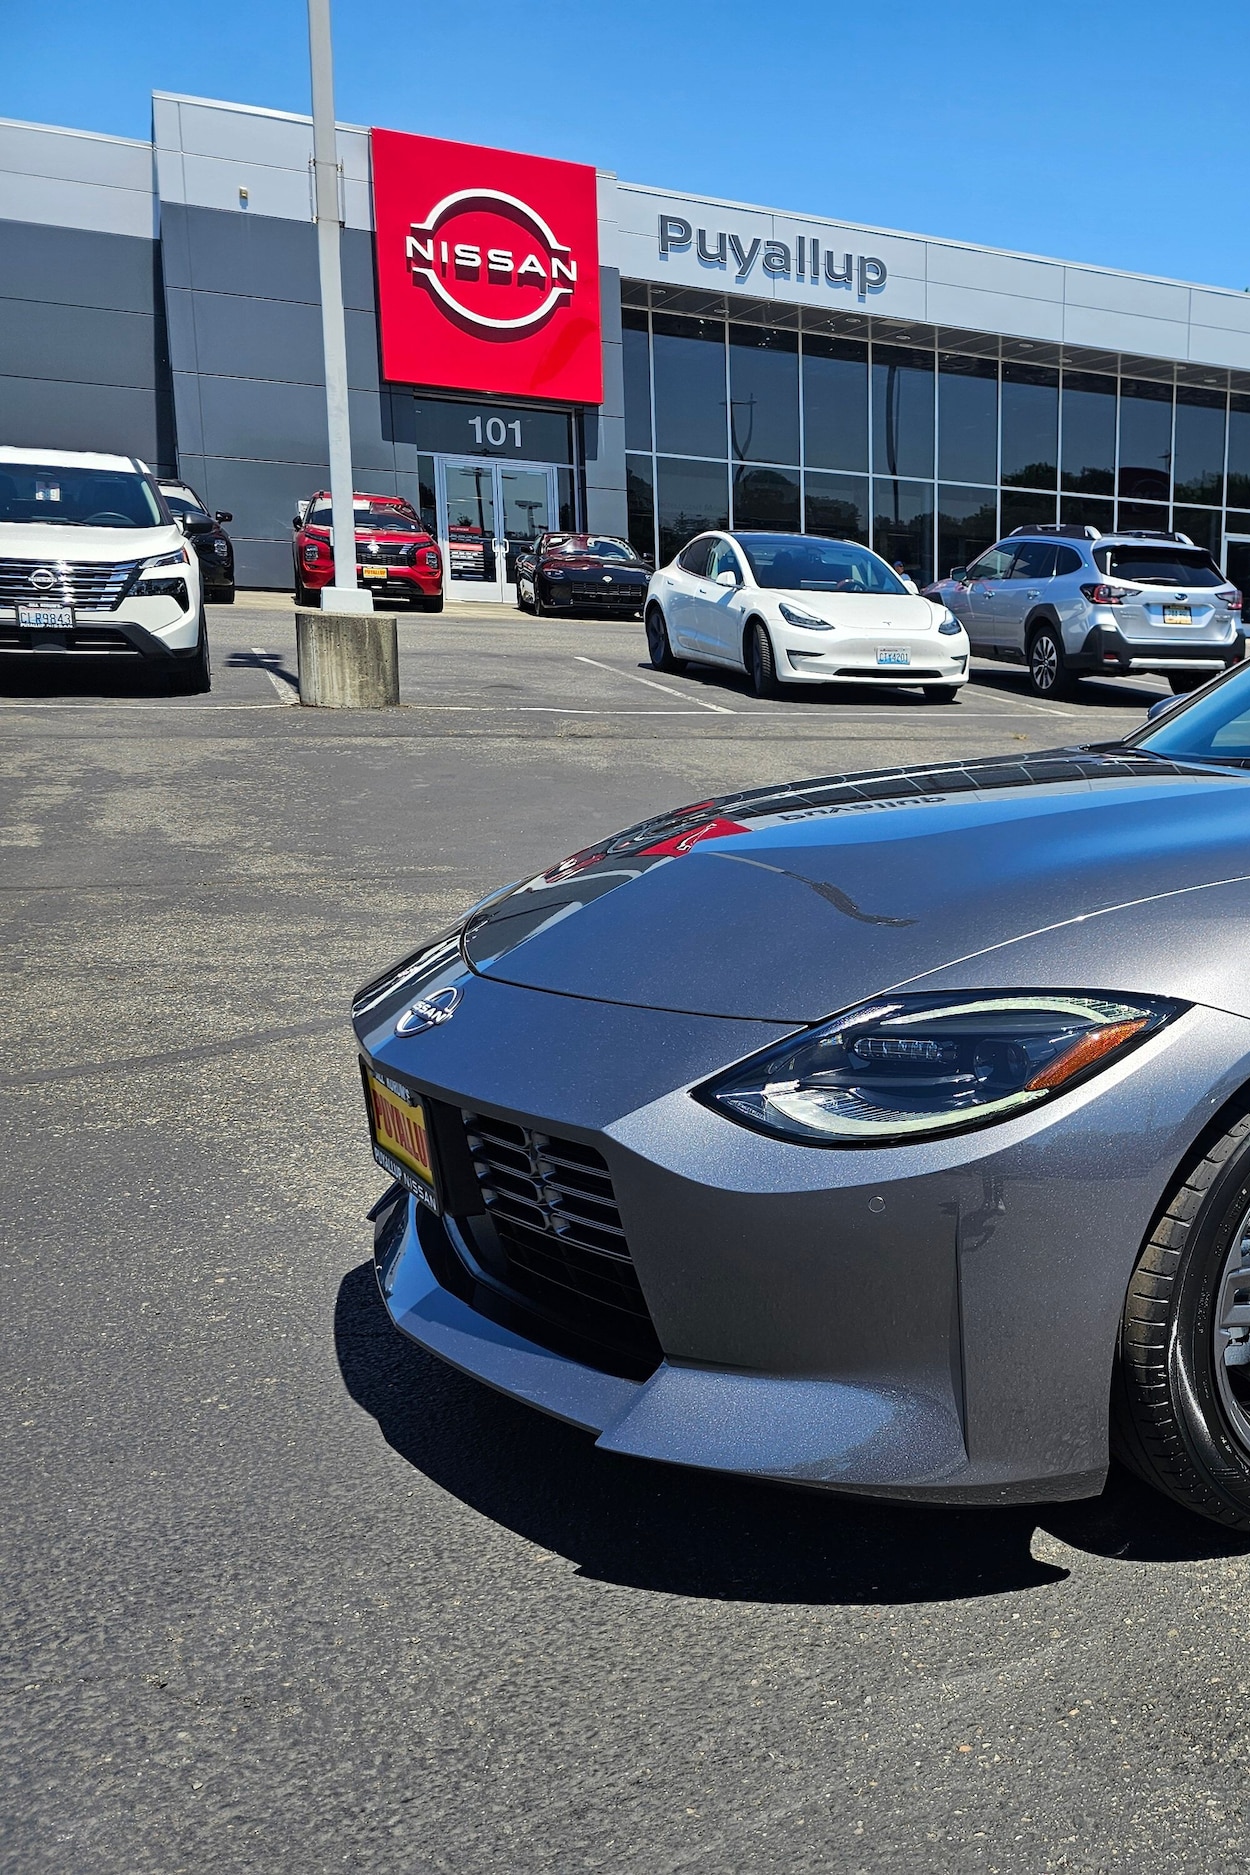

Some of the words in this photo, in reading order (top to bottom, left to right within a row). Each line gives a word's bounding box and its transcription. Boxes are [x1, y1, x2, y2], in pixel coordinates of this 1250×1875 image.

[406, 235, 578, 282] NISSAN
[658, 213, 888, 297] Puyallup
[468, 415, 523, 448] 101
[20, 612, 71, 625] CLR9843
[372, 1087, 429, 1168] PUYALLU
[374, 1145, 402, 1181] PUYALLUP
[402, 1171, 437, 1211] NISSAN
